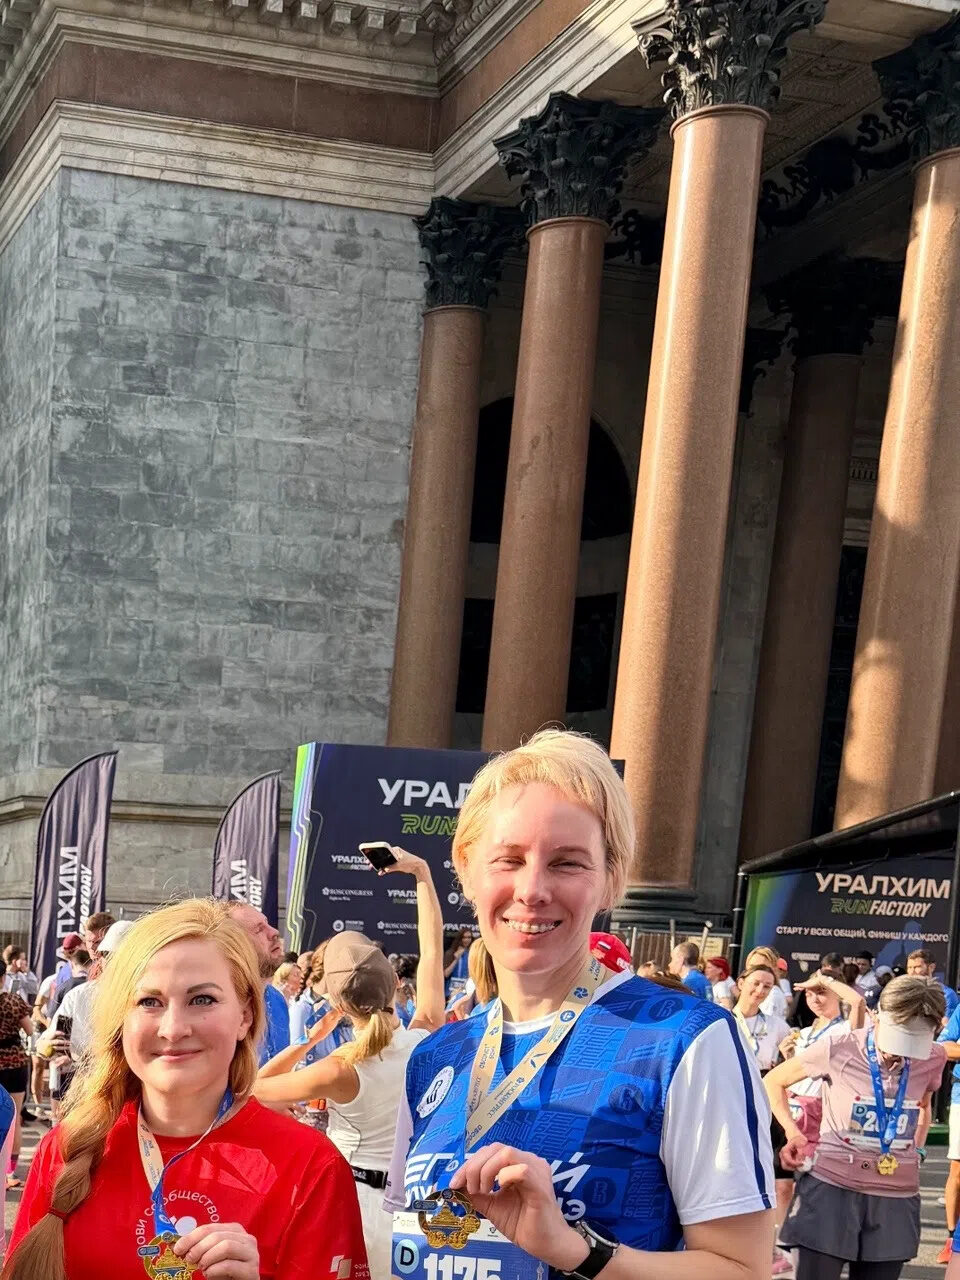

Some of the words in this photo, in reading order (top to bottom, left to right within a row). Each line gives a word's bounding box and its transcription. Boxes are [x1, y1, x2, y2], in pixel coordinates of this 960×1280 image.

[815, 872, 951, 899] УРАЛХИМ
[776, 926, 803, 935] СТАРТ
[804, 927, 810, 935] У
[810, 928, 833, 936] ВСЕХ
[868, 930, 902, 939] ФИНИШ
[902, 932, 908, 940] У
[908, 932, 949, 943] КАЖДОГО
[863, 1111, 908, 1135] 29
[135, 1218, 148, 1246] ови
[400, 1245, 414, 1266] D
